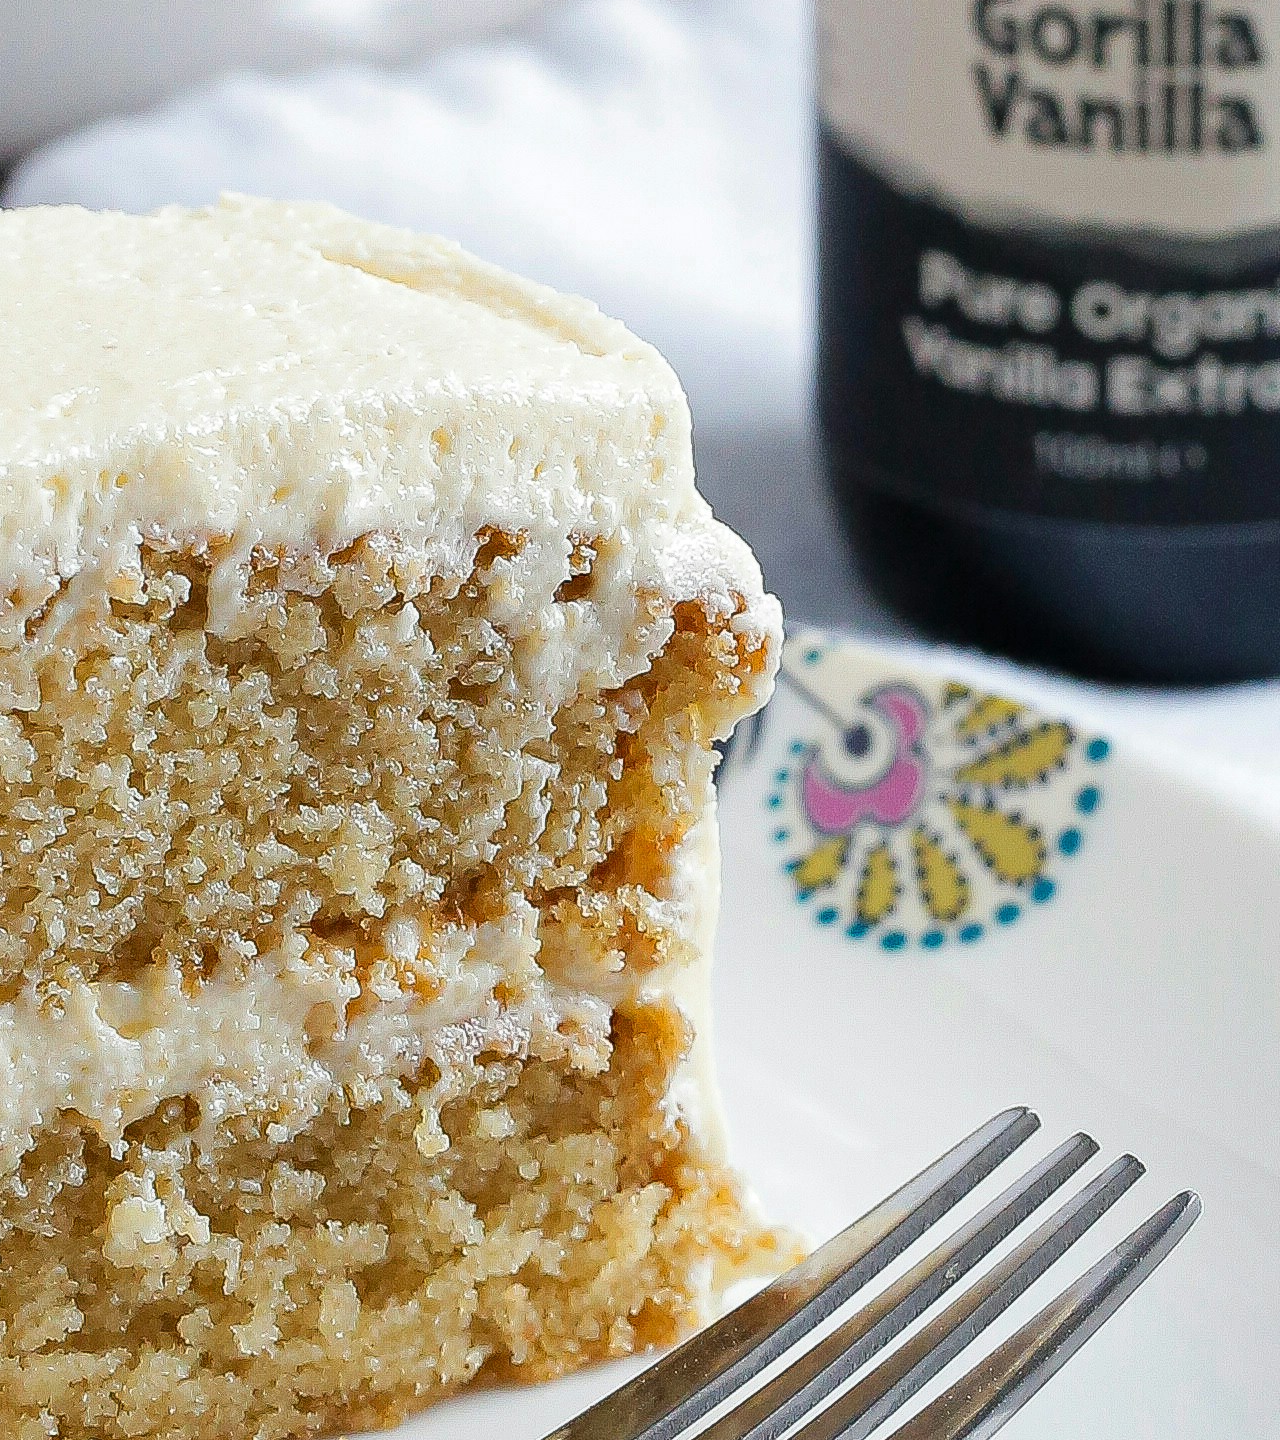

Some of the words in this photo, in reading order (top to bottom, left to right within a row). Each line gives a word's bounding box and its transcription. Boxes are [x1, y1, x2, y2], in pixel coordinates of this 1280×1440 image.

[973, 62, 1263, 151] Vanilla
[919, 249, 1060, 333] Pure
[904, 316, 1100, 412] Vanilla
